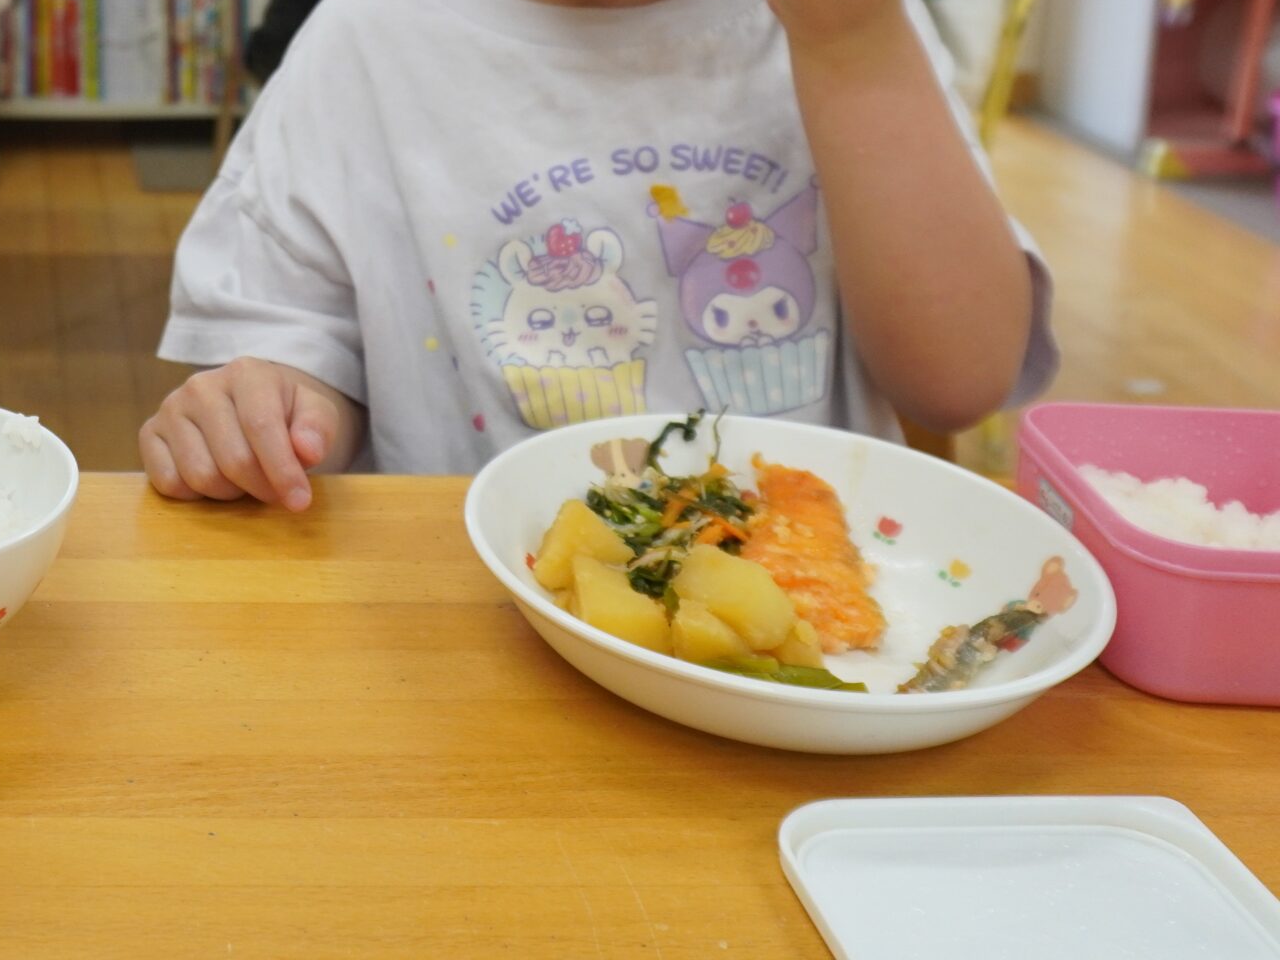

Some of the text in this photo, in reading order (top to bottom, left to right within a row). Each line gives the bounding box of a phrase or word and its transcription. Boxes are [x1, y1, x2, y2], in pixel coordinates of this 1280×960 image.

[491, 144, 789, 225] WE'RE SO SWEET!
